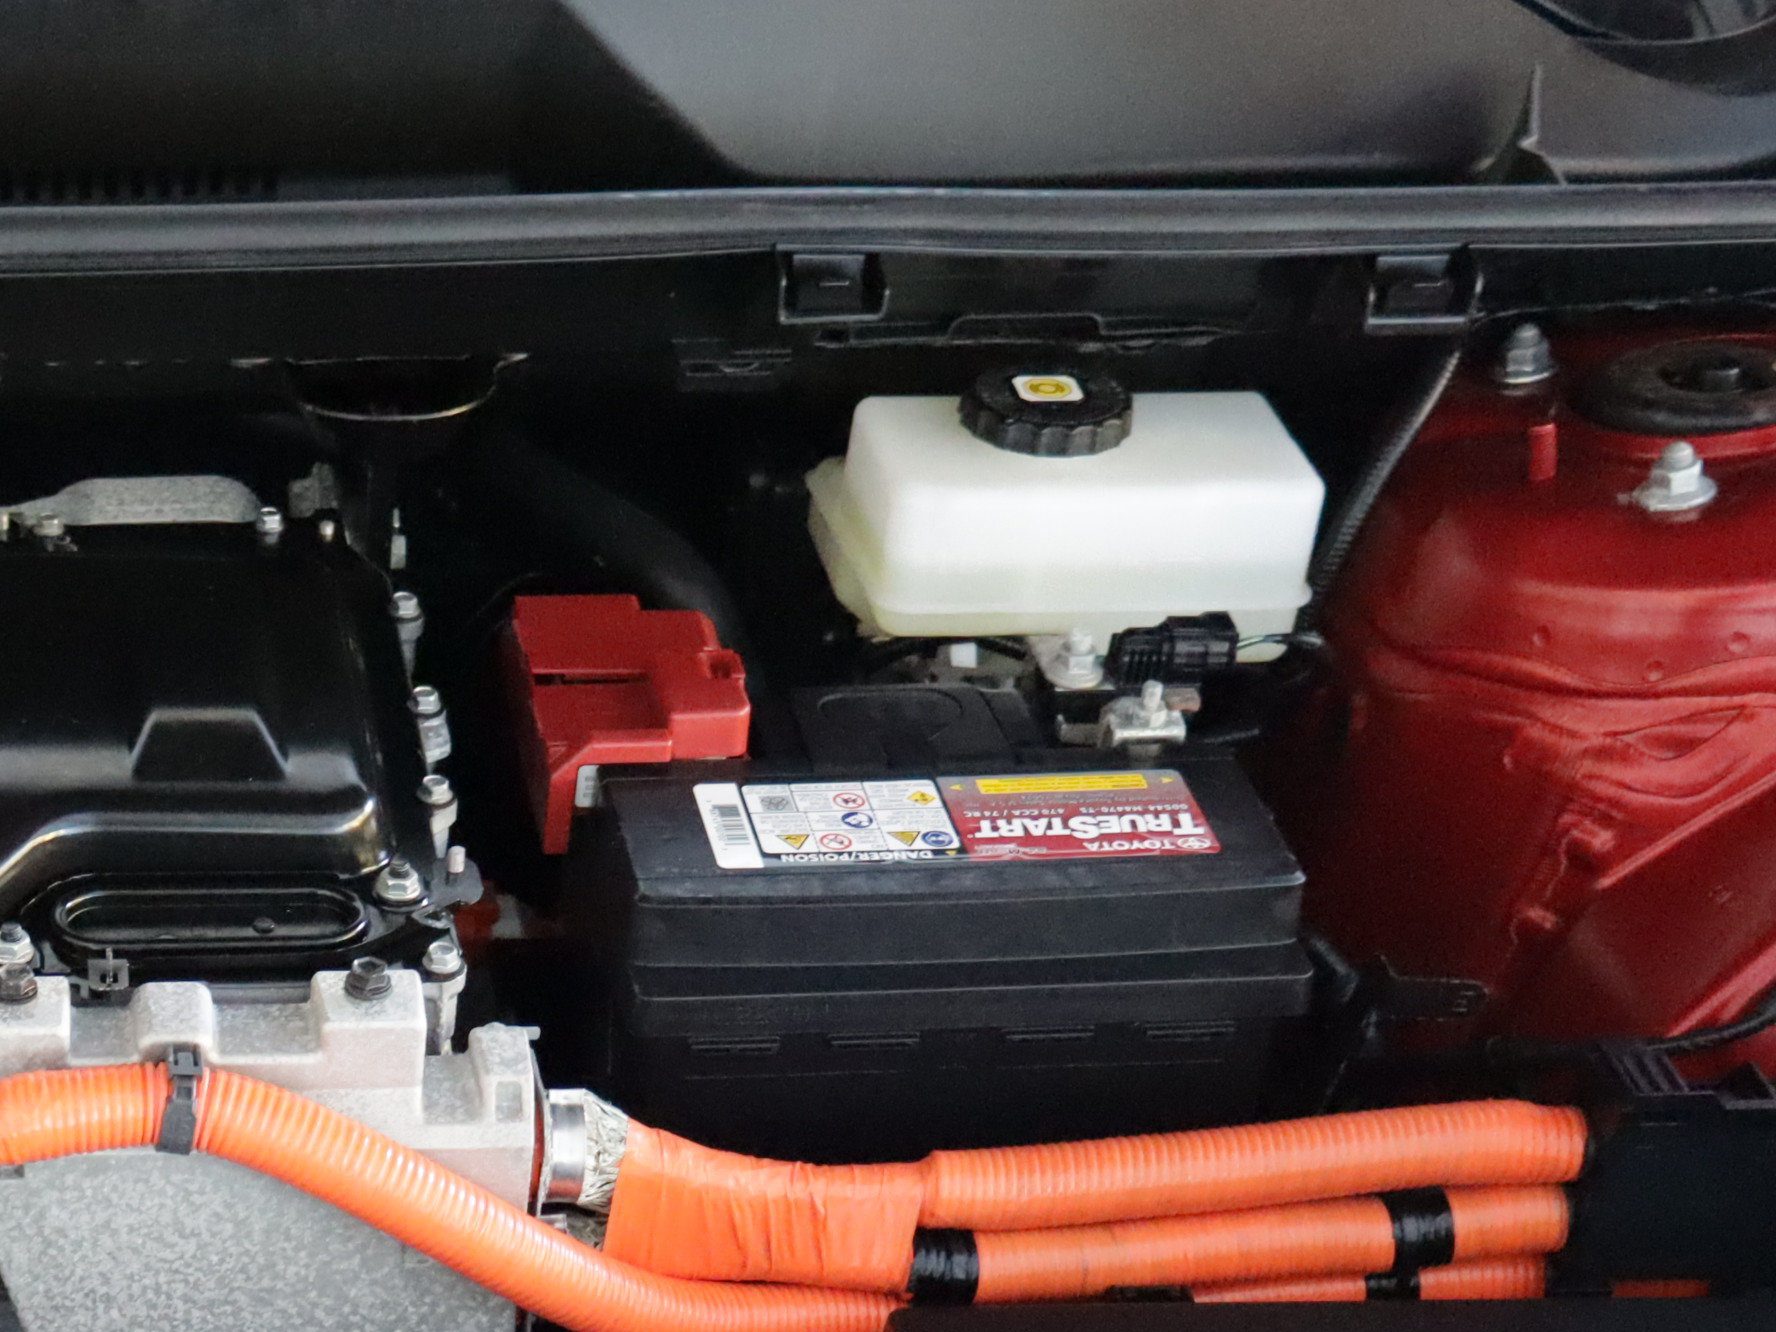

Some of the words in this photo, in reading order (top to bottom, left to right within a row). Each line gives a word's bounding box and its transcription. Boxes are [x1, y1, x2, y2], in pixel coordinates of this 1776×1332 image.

[963, 810, 981, 818] RC
[1010, 808, 1039, 816] CCA
[1083, 839, 1176, 851] TOYOTA
[780, 850, 935, 863] DANGER/POISON
